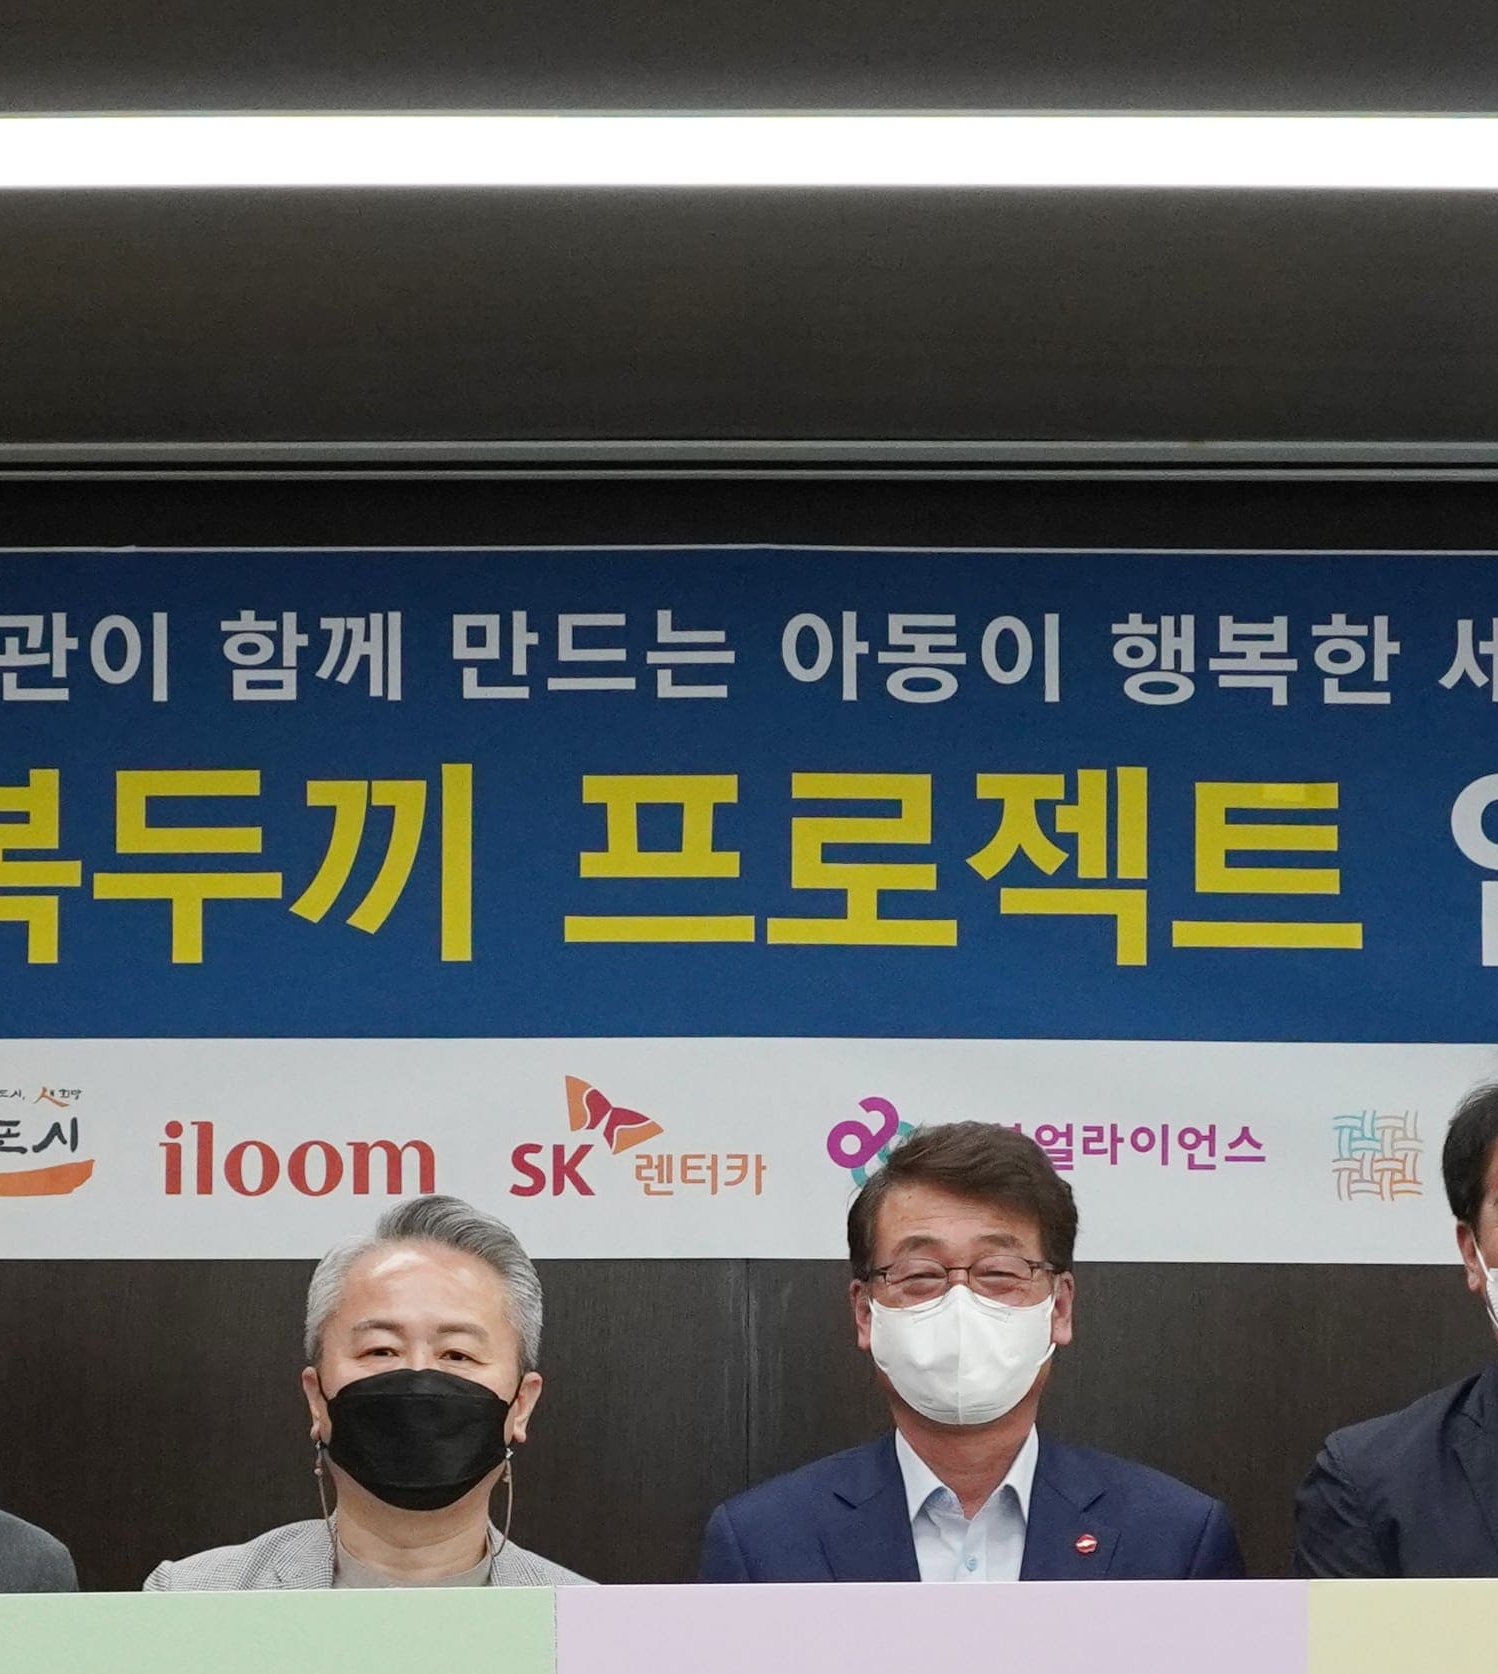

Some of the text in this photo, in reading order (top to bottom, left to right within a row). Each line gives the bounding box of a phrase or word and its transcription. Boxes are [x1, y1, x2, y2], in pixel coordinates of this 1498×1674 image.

[220, 610, 404, 703] 함께
[453, 610, 737, 701] 만드는
[782, 611, 1062, 705] 아동이
[1111, 613, 1402, 708] 행복한
[564, 766, 1364, 967] 프로젝트
[158, 1119, 437, 1198] iloom
[508, 1142, 767, 1198] SK 렌터카
[992, 1122, 1267, 1171] 얼라이언스
